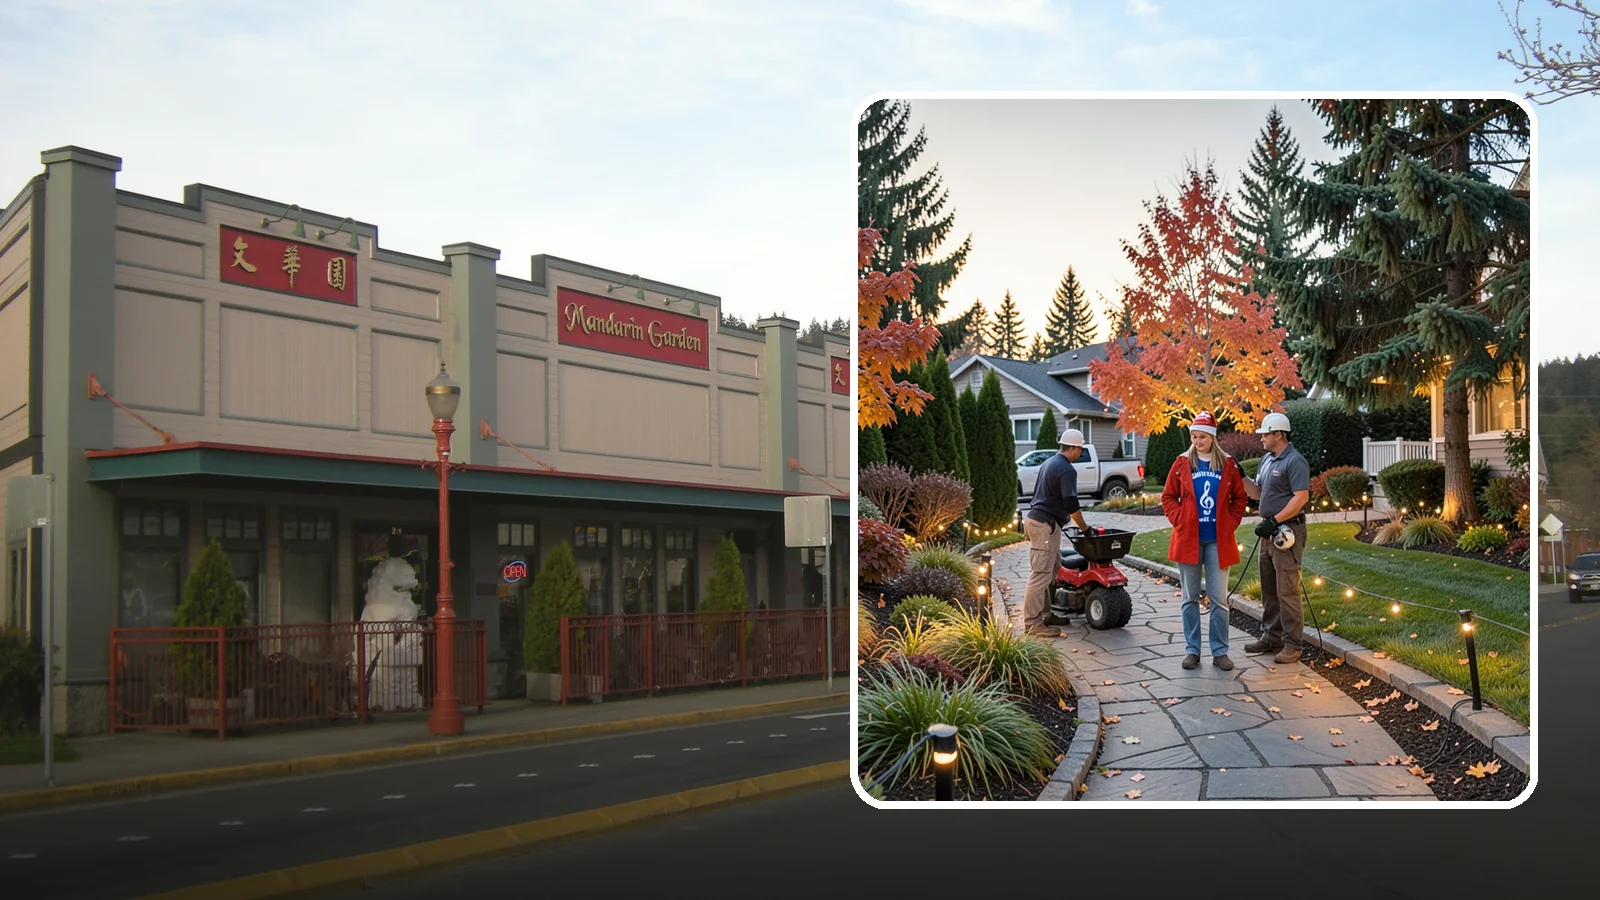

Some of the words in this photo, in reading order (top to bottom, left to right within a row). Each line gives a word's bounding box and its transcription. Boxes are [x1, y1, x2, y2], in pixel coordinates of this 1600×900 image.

[564, 302, 644, 341] Mandarin
[648, 320, 702, 352] Garden
[503, 565, 527, 578] OPEN
